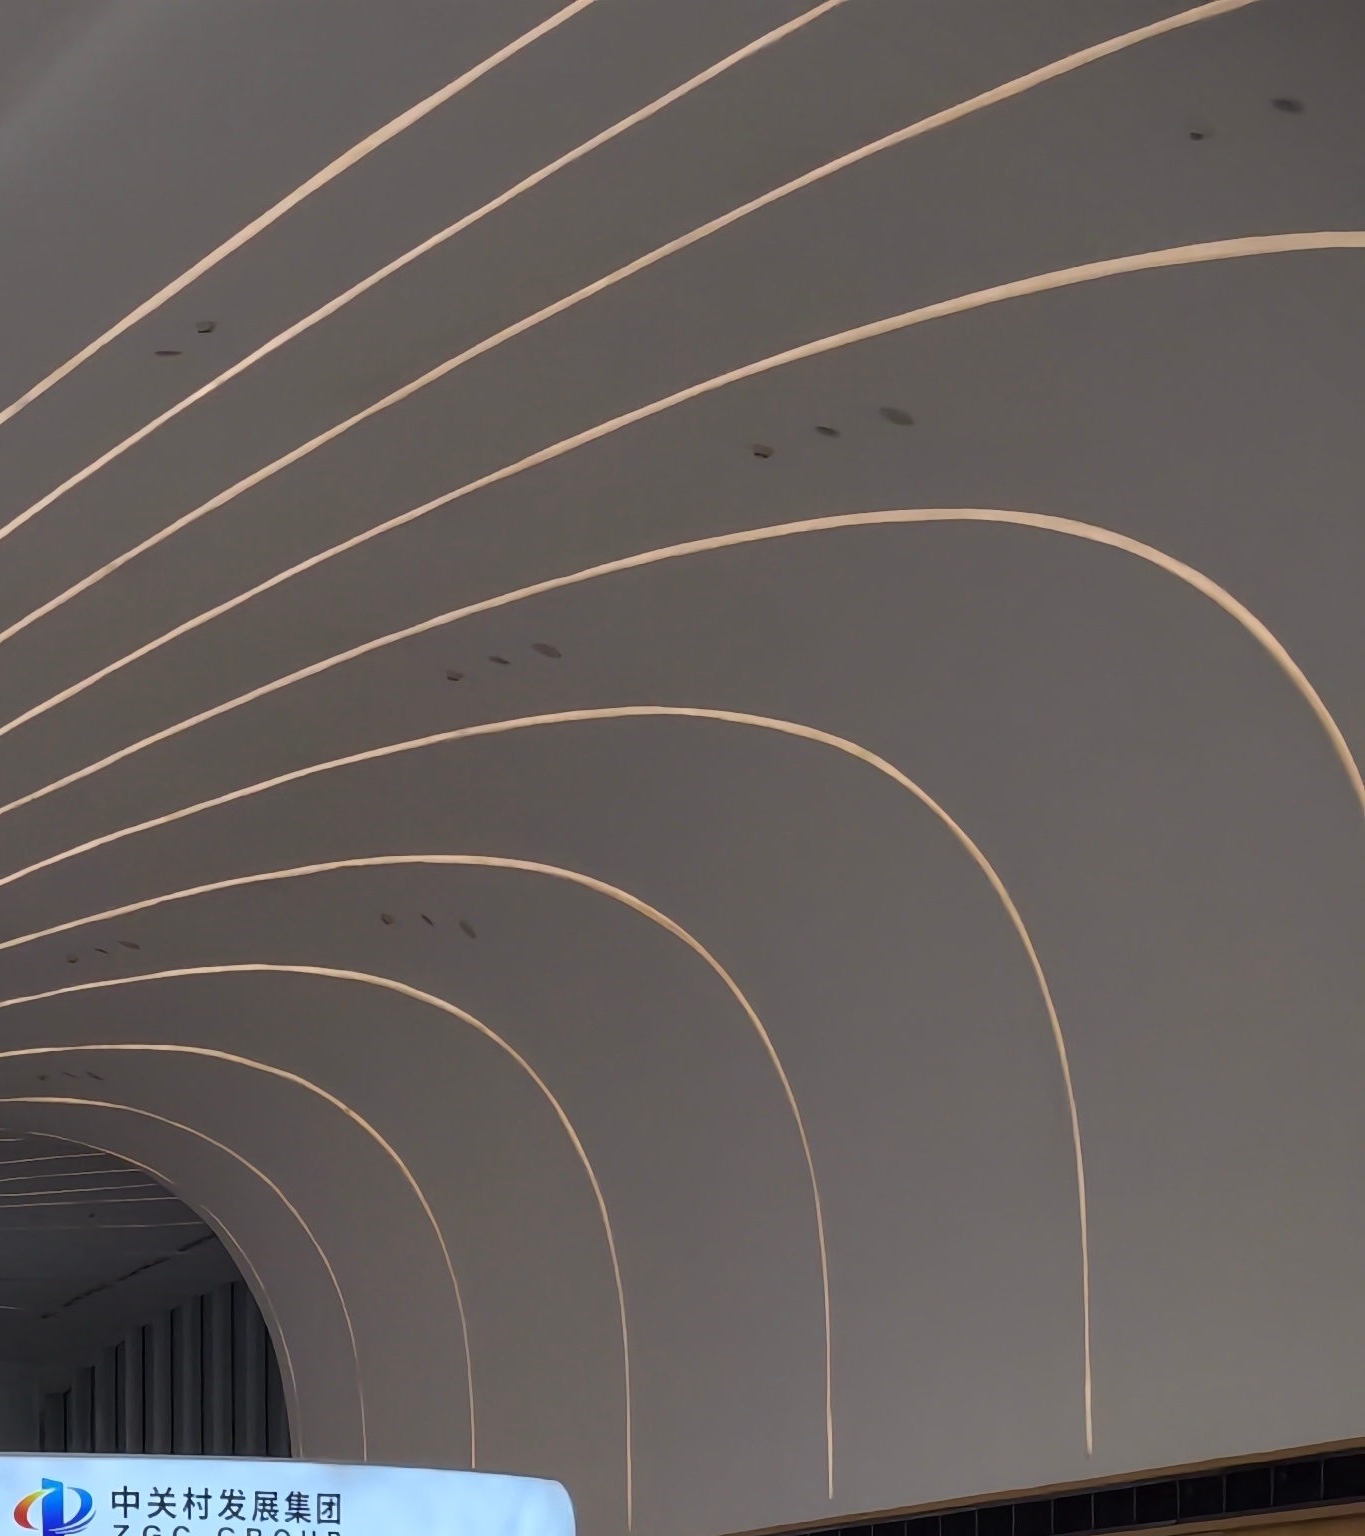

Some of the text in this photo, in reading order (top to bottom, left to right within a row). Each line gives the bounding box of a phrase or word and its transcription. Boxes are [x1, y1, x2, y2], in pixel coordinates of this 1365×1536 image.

[111, 1485, 342, 1525] 中关村发展集团
